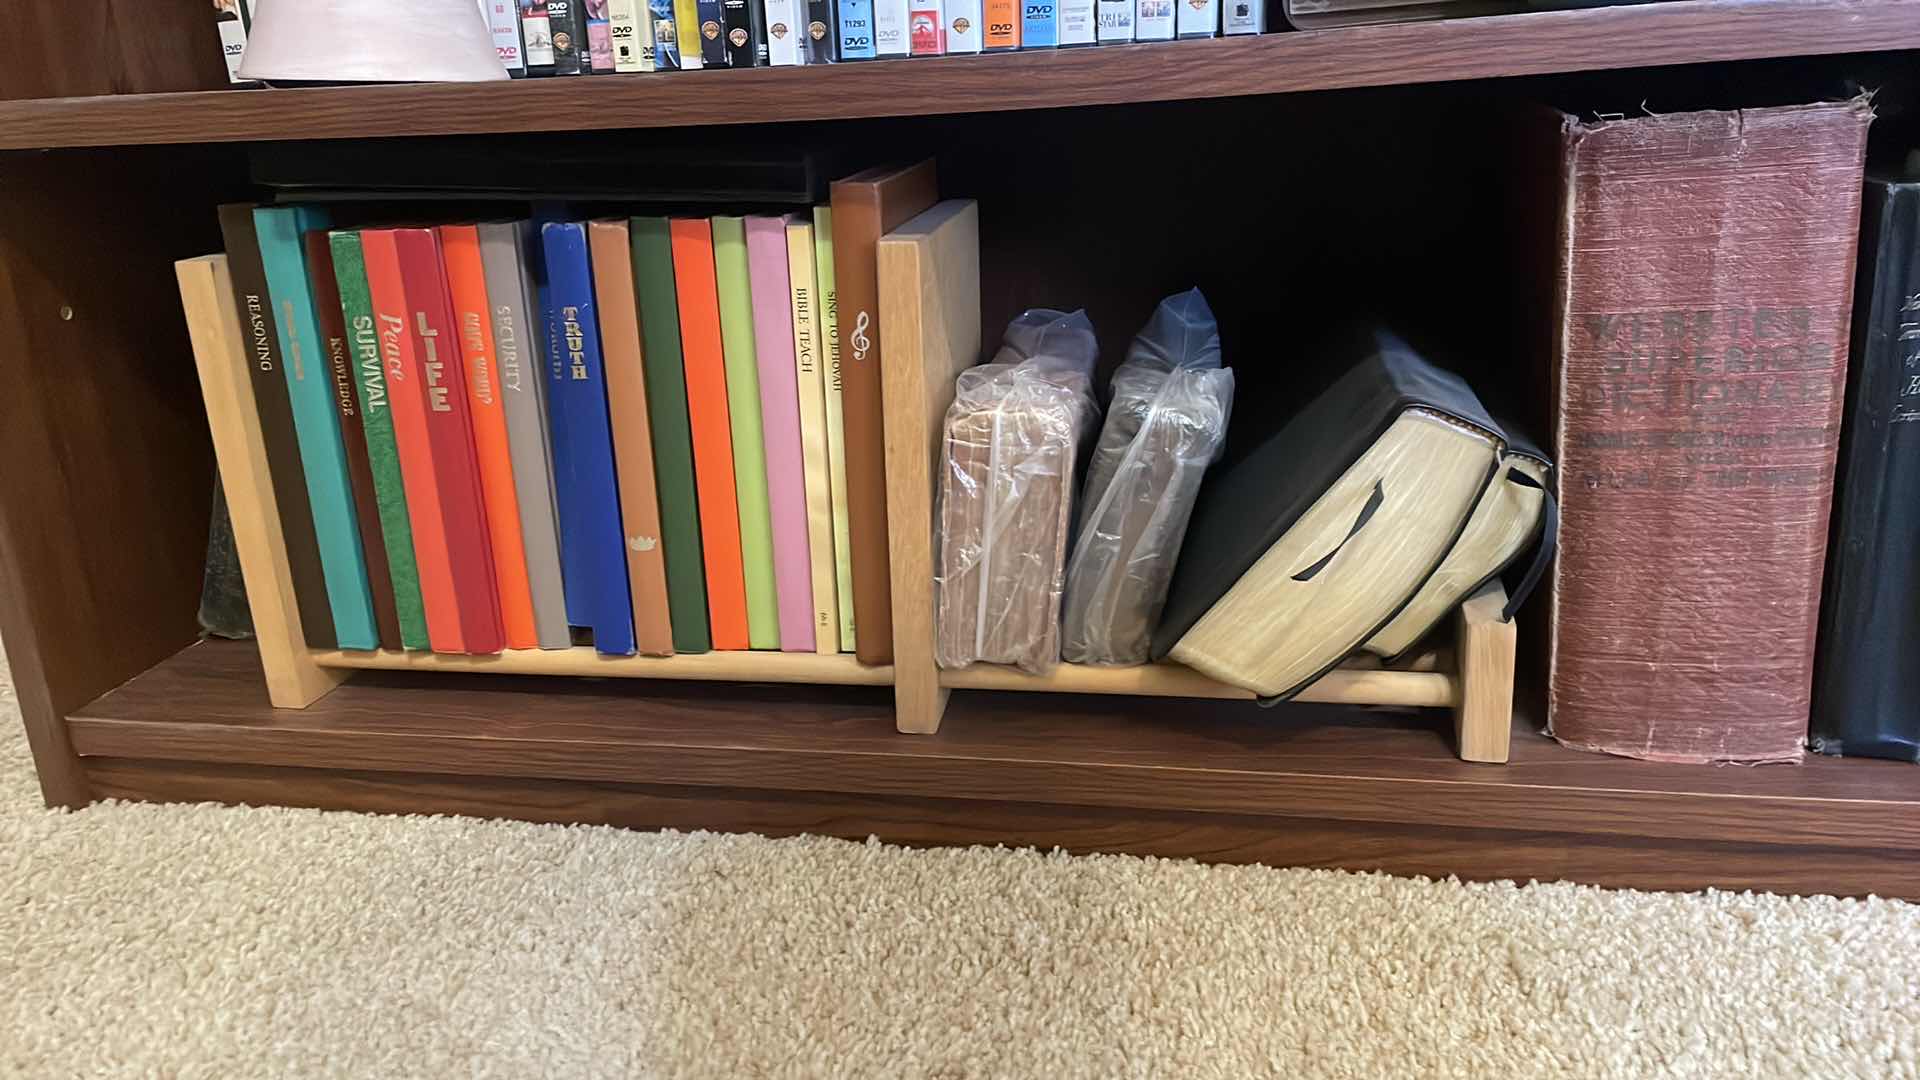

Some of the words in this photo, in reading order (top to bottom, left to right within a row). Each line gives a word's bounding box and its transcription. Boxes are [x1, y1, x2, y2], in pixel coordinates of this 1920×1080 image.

[547, 2, 568, 10] DVD
[1026, 6, 1053, 14] DVD
[612, 26, 632, 34] DVD
[844, 37, 869, 46] DVD
[796, 288, 809, 325] BIBLE
[827, 291, 838, 319] SING
[246, 294, 273, 371] REASONING
[379, 311, 405, 382] Peace
[496, 305, 521, 393] SECURITY
[563, 306, 589, 381] TRUTH
[800, 328, 813, 373] TEACH
[830, 324, 839, 338] TO
[330, 337, 354, 416] KNOWLEDGE
[353, 315, 388, 414] SURVIVAL
[416, 311, 452, 412] LIFE
[830, 342, 842, 392] JEHOVAH
